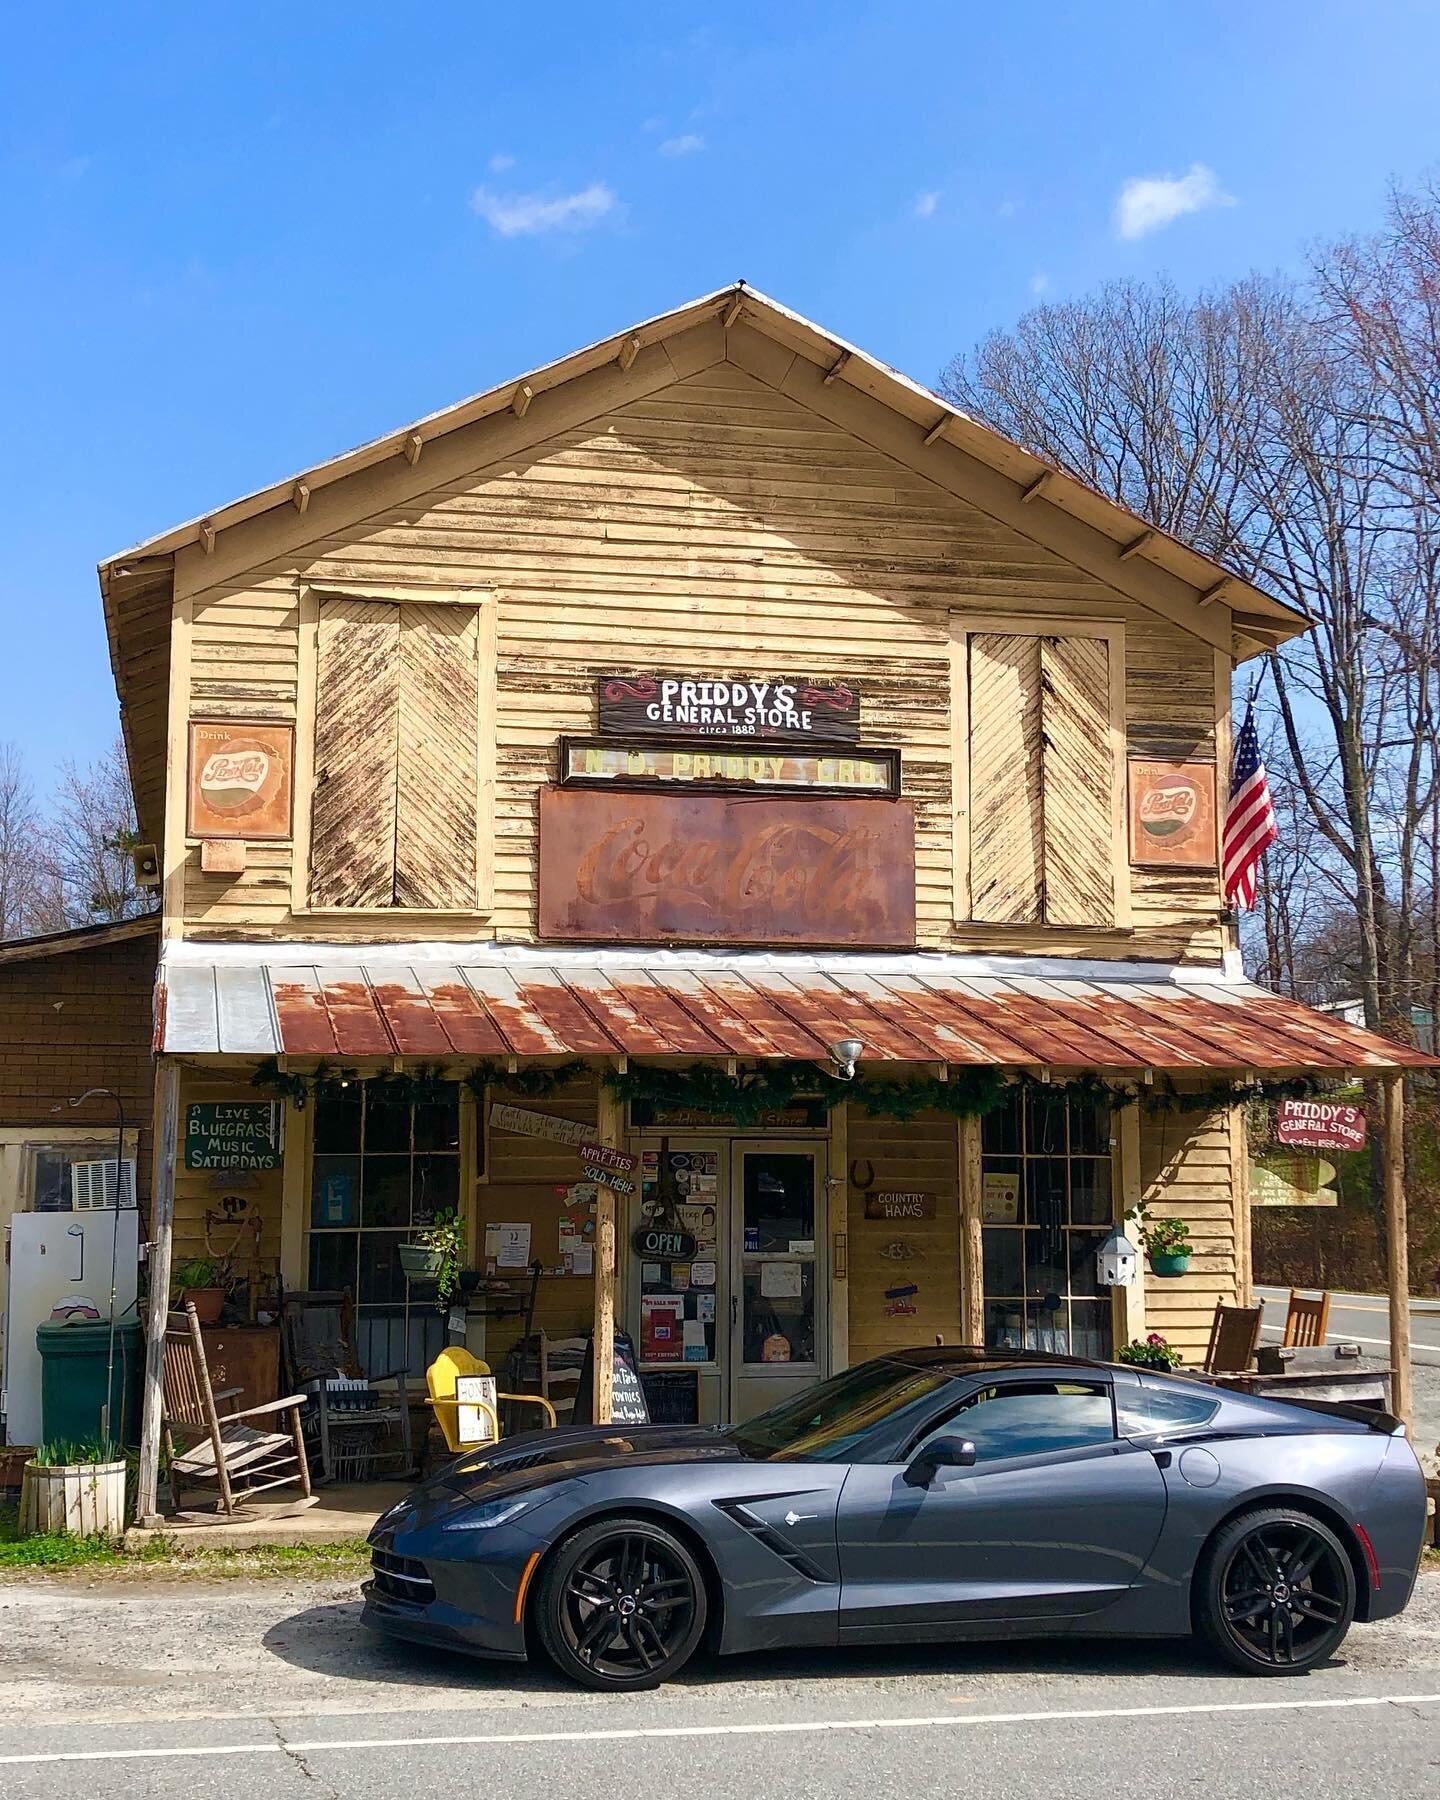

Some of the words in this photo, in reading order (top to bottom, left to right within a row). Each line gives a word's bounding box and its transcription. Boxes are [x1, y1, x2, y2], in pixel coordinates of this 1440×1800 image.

[661, 680, 797, 711] PRIDDY'S
[647, 703, 738, 724] GENERAL
[745, 708, 812, 730] STORE
[199, 731, 232, 741] Drink
[699, 726, 727, 735] circa
[732, 725, 756, 735] 1888
[672, 753, 785, 781] PRIDDY
[215, 1105, 250, 1119] LIVE
[1284, 1100, 1357, 1123] PRIDDY'S
[189, 1120, 275, 1139] BLUEGRASS
[1280, 1119, 1328, 1132] GENERAL
[1328, 1121, 1364, 1143] STORE
[207, 1138, 256, 1153] MUSIC
[191, 1150, 275, 1168] SATURDAYS
[581, 1147, 607, 1162] APPLE
[610, 1155, 632, 1170] PIES
[583, 1165, 606, 1183] SOLD
[610, 1176, 634, 1193] HERE
[879, 1193, 925, 1203] COUNTRY
[885, 1203, 923, 1218] HAMS
[646, 1232, 682, 1252] OPEN
[611, 1389, 641, 1403] rownies
